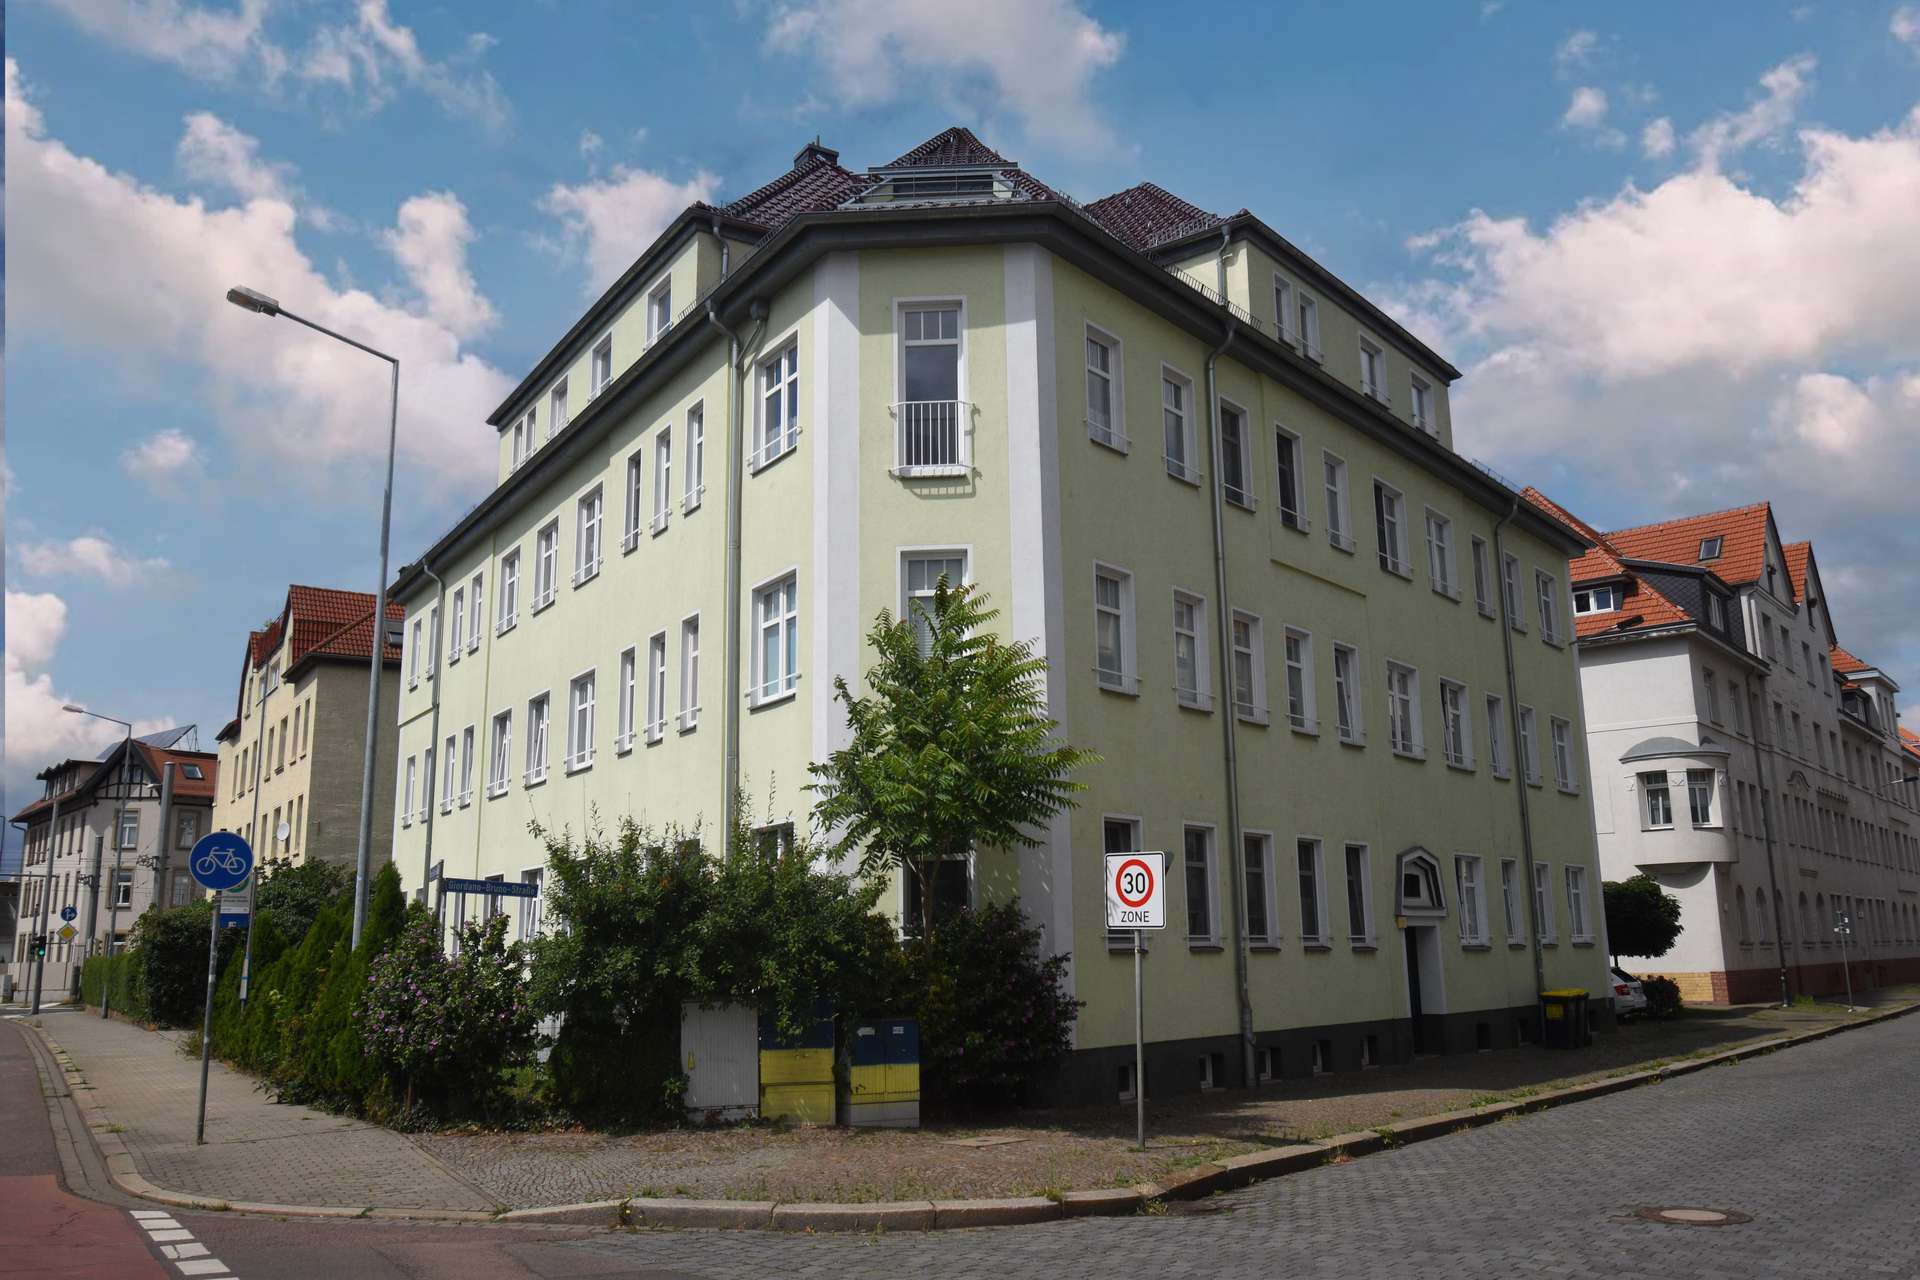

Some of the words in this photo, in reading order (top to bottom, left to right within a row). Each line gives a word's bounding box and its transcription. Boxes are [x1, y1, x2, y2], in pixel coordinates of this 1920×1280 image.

[448, 880, 535, 895] Giordano-Bruno-Straße
[1124, 873, 1145, 894] 30
[1121, 911, 1150, 923] ZONE
